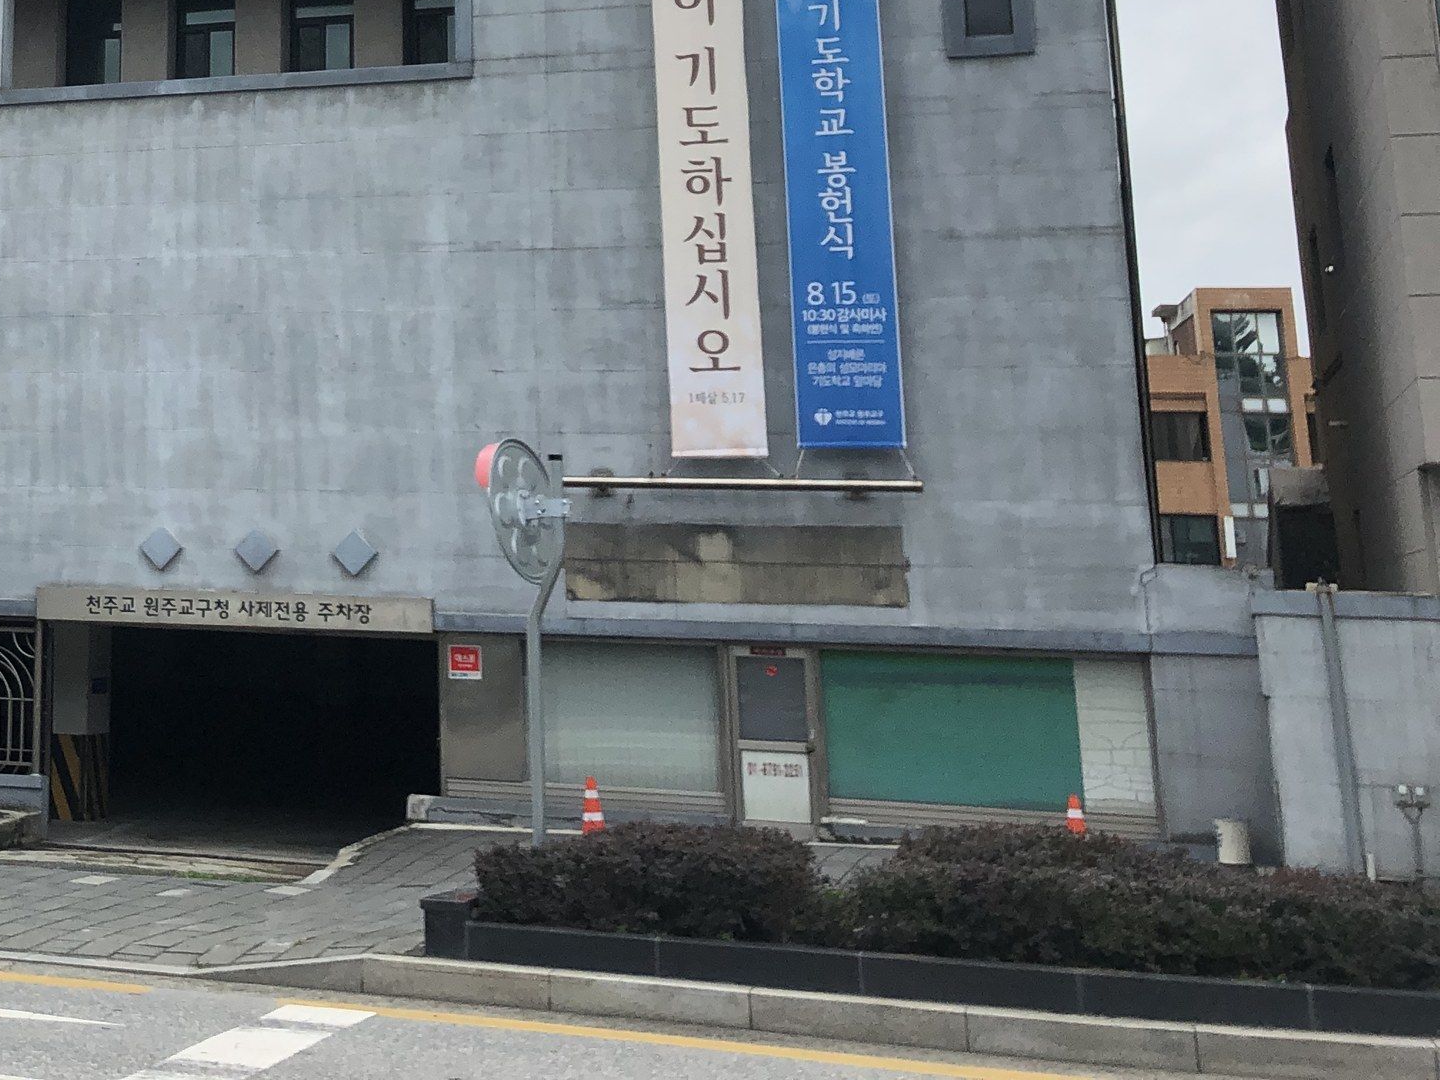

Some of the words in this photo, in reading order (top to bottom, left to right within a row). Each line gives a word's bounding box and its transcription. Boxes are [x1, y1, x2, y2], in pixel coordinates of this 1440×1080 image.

[676, 45, 741, 373] 기도하십시오
[817, 151, 857, 260] 봉헌식
[85, 595, 136, 616] 천주교
[144, 596, 230, 620] 원주교구청
[238, 600, 310, 623] 사제전용
[318, 602, 373, 625] 주차장
